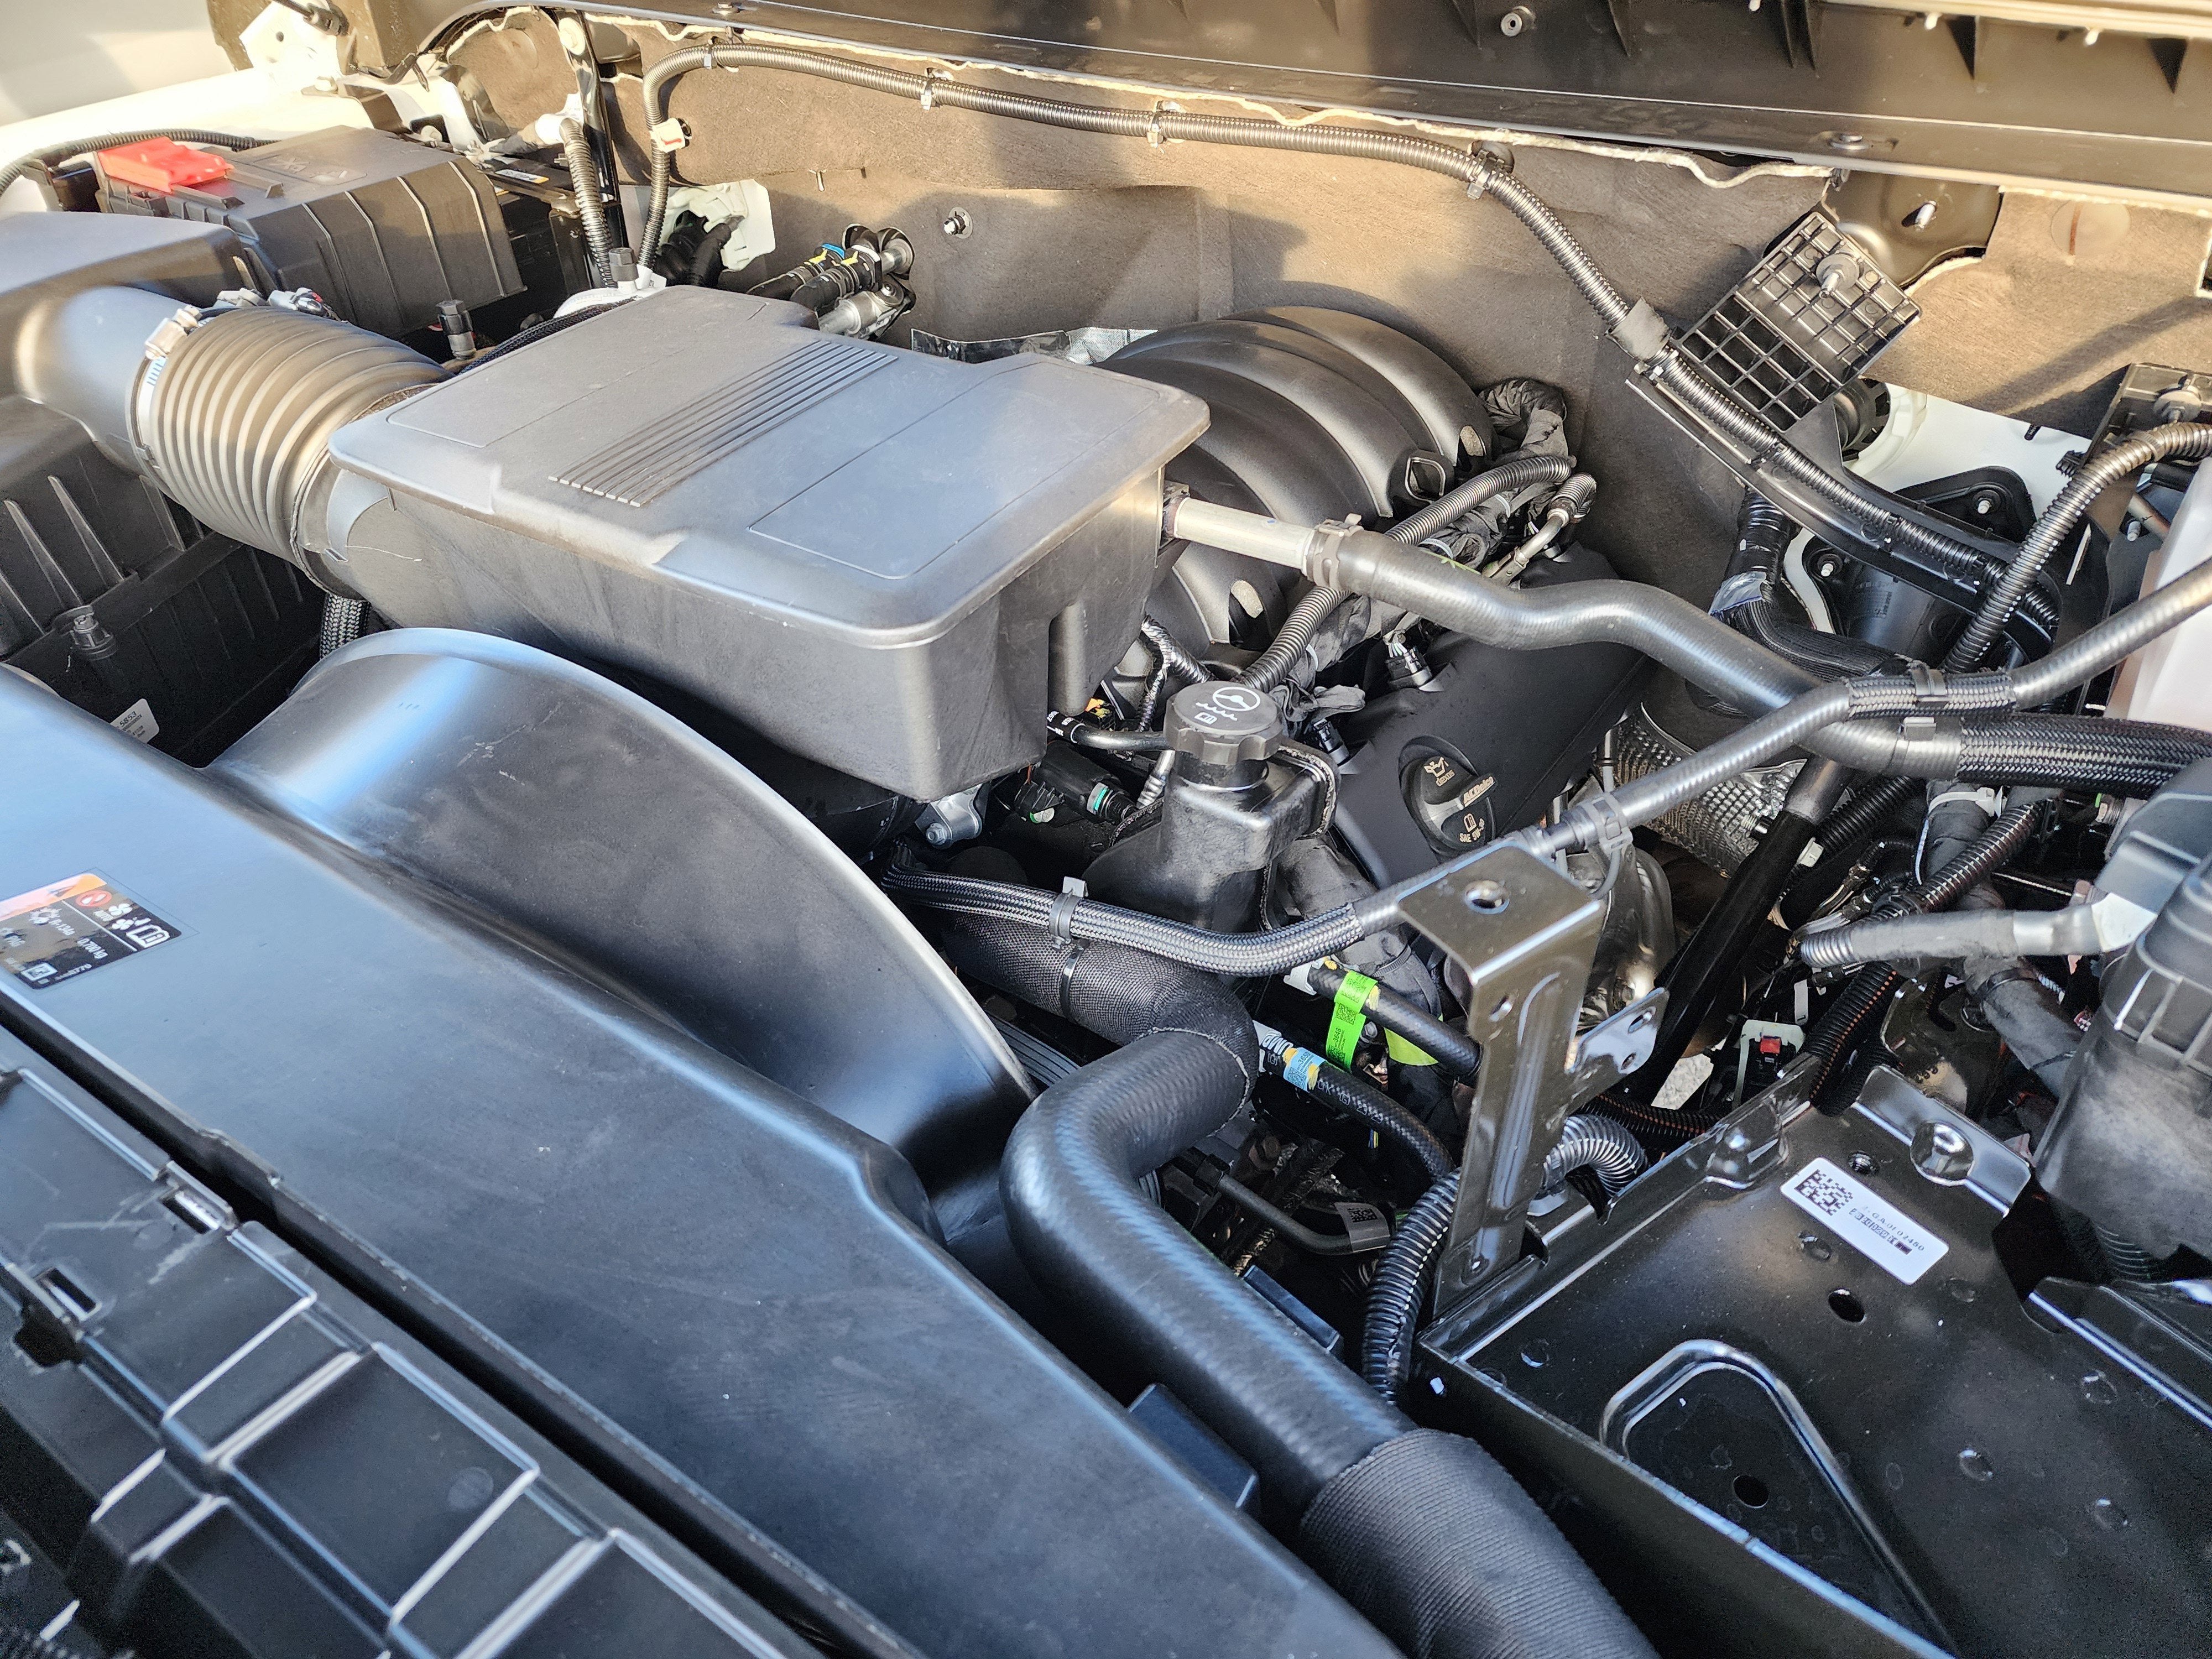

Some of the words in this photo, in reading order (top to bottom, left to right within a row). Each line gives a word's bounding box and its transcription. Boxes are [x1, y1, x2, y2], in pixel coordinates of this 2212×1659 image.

[1464, 776, 1494, 804] ACDelco
[1459, 832, 1472, 843] SAE
[1472, 818, 1485, 841] 5W-30
